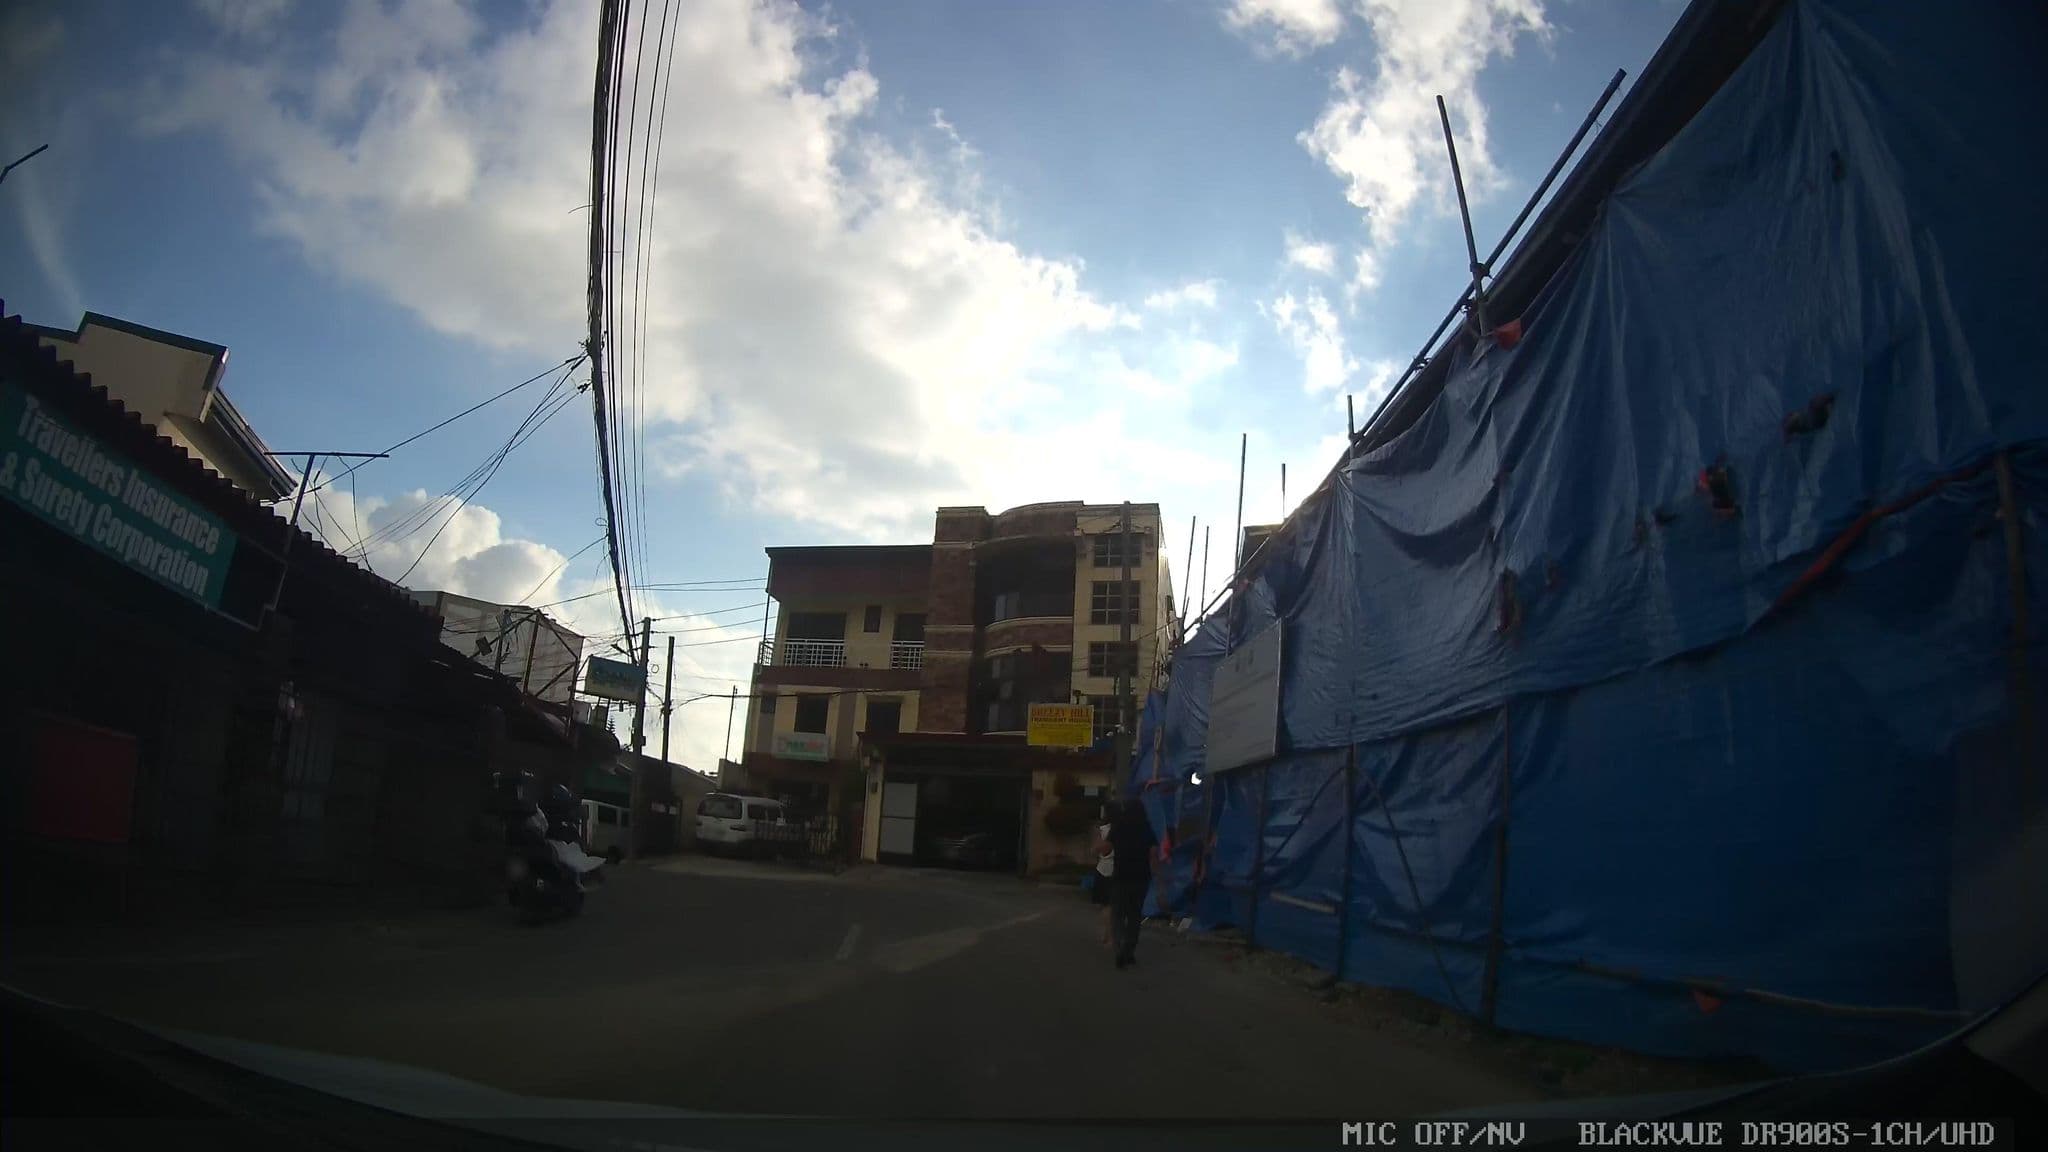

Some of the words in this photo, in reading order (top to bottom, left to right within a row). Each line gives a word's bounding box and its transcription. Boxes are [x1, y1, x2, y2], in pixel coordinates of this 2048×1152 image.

[0, 452, 18, 491] &
[20, 456, 95, 537] Surety
[93, 503, 209, 597] Corporation
[18, 394, 125, 497] Travellers
[123, 468, 220, 556] Insurance
